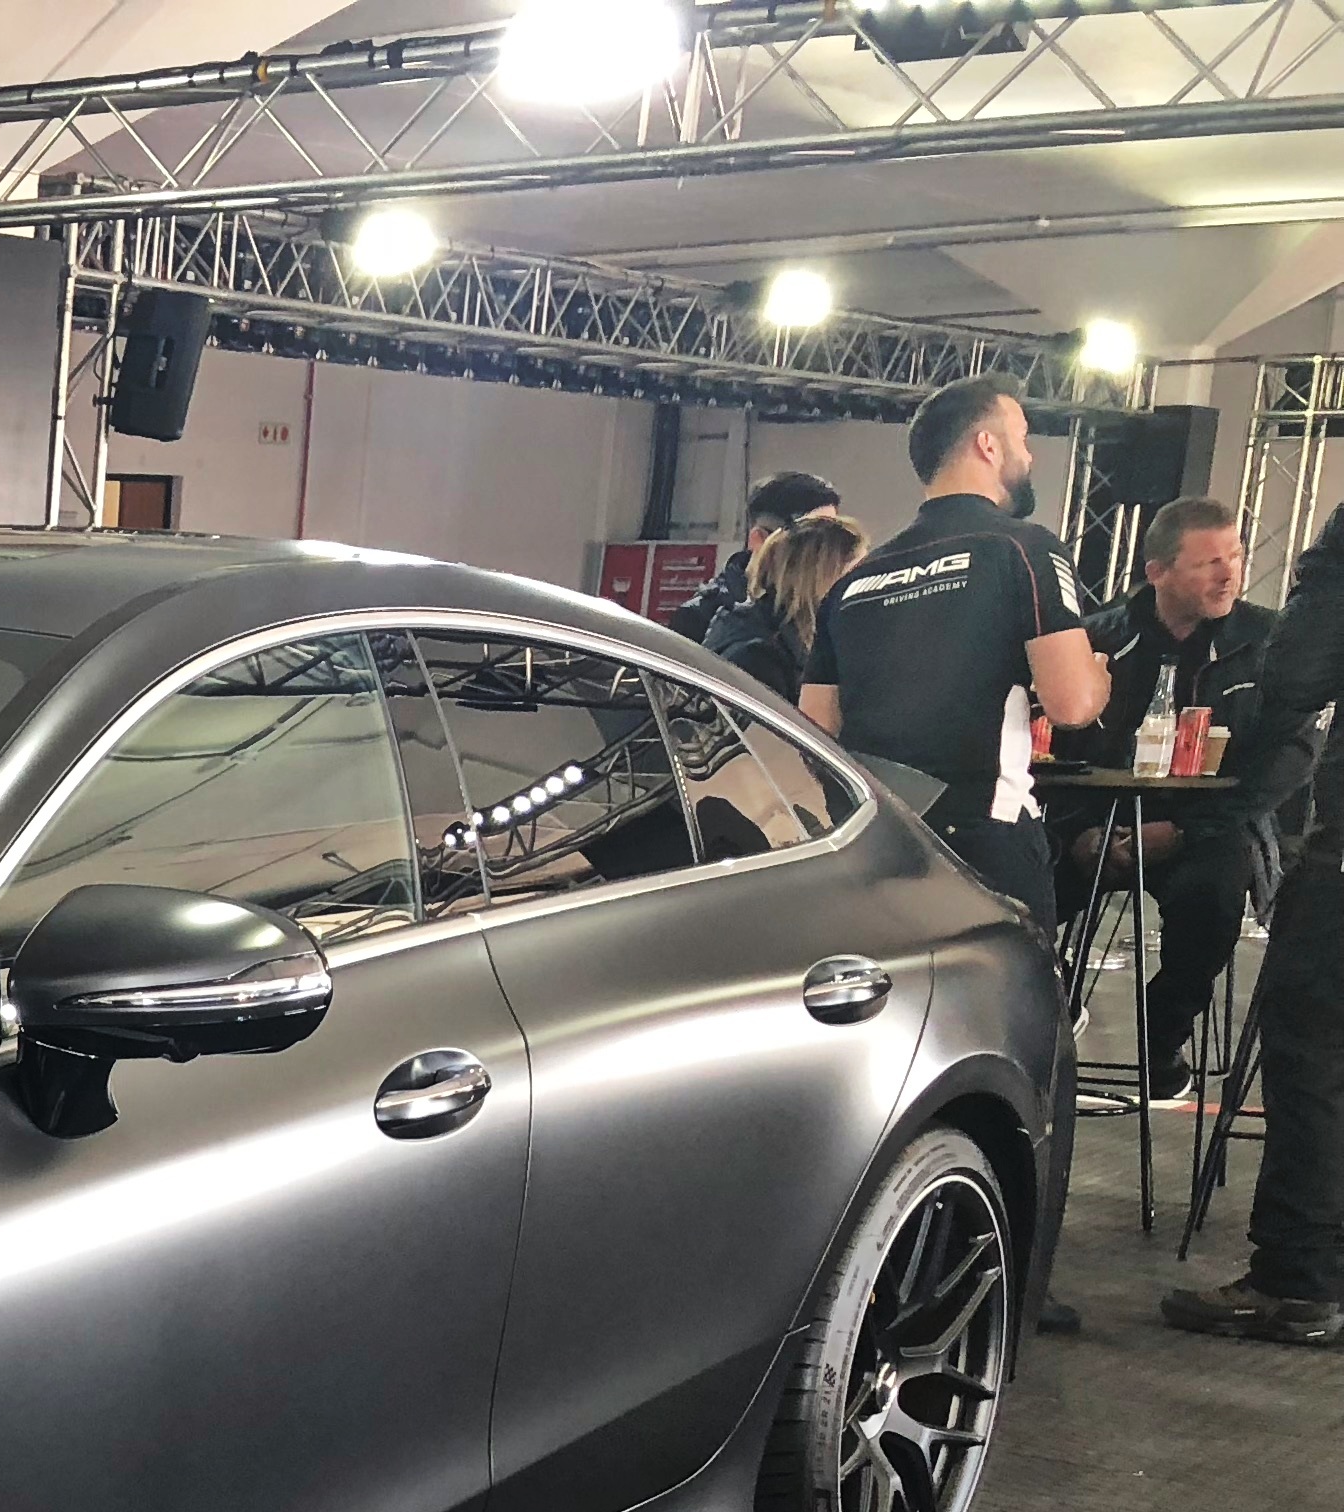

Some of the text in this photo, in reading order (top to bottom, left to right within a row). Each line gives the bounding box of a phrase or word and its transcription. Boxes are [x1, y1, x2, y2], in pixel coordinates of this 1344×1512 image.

[877, 552, 971, 590] AMG
[883, 580, 968, 607] DRIVING ACADEMY
